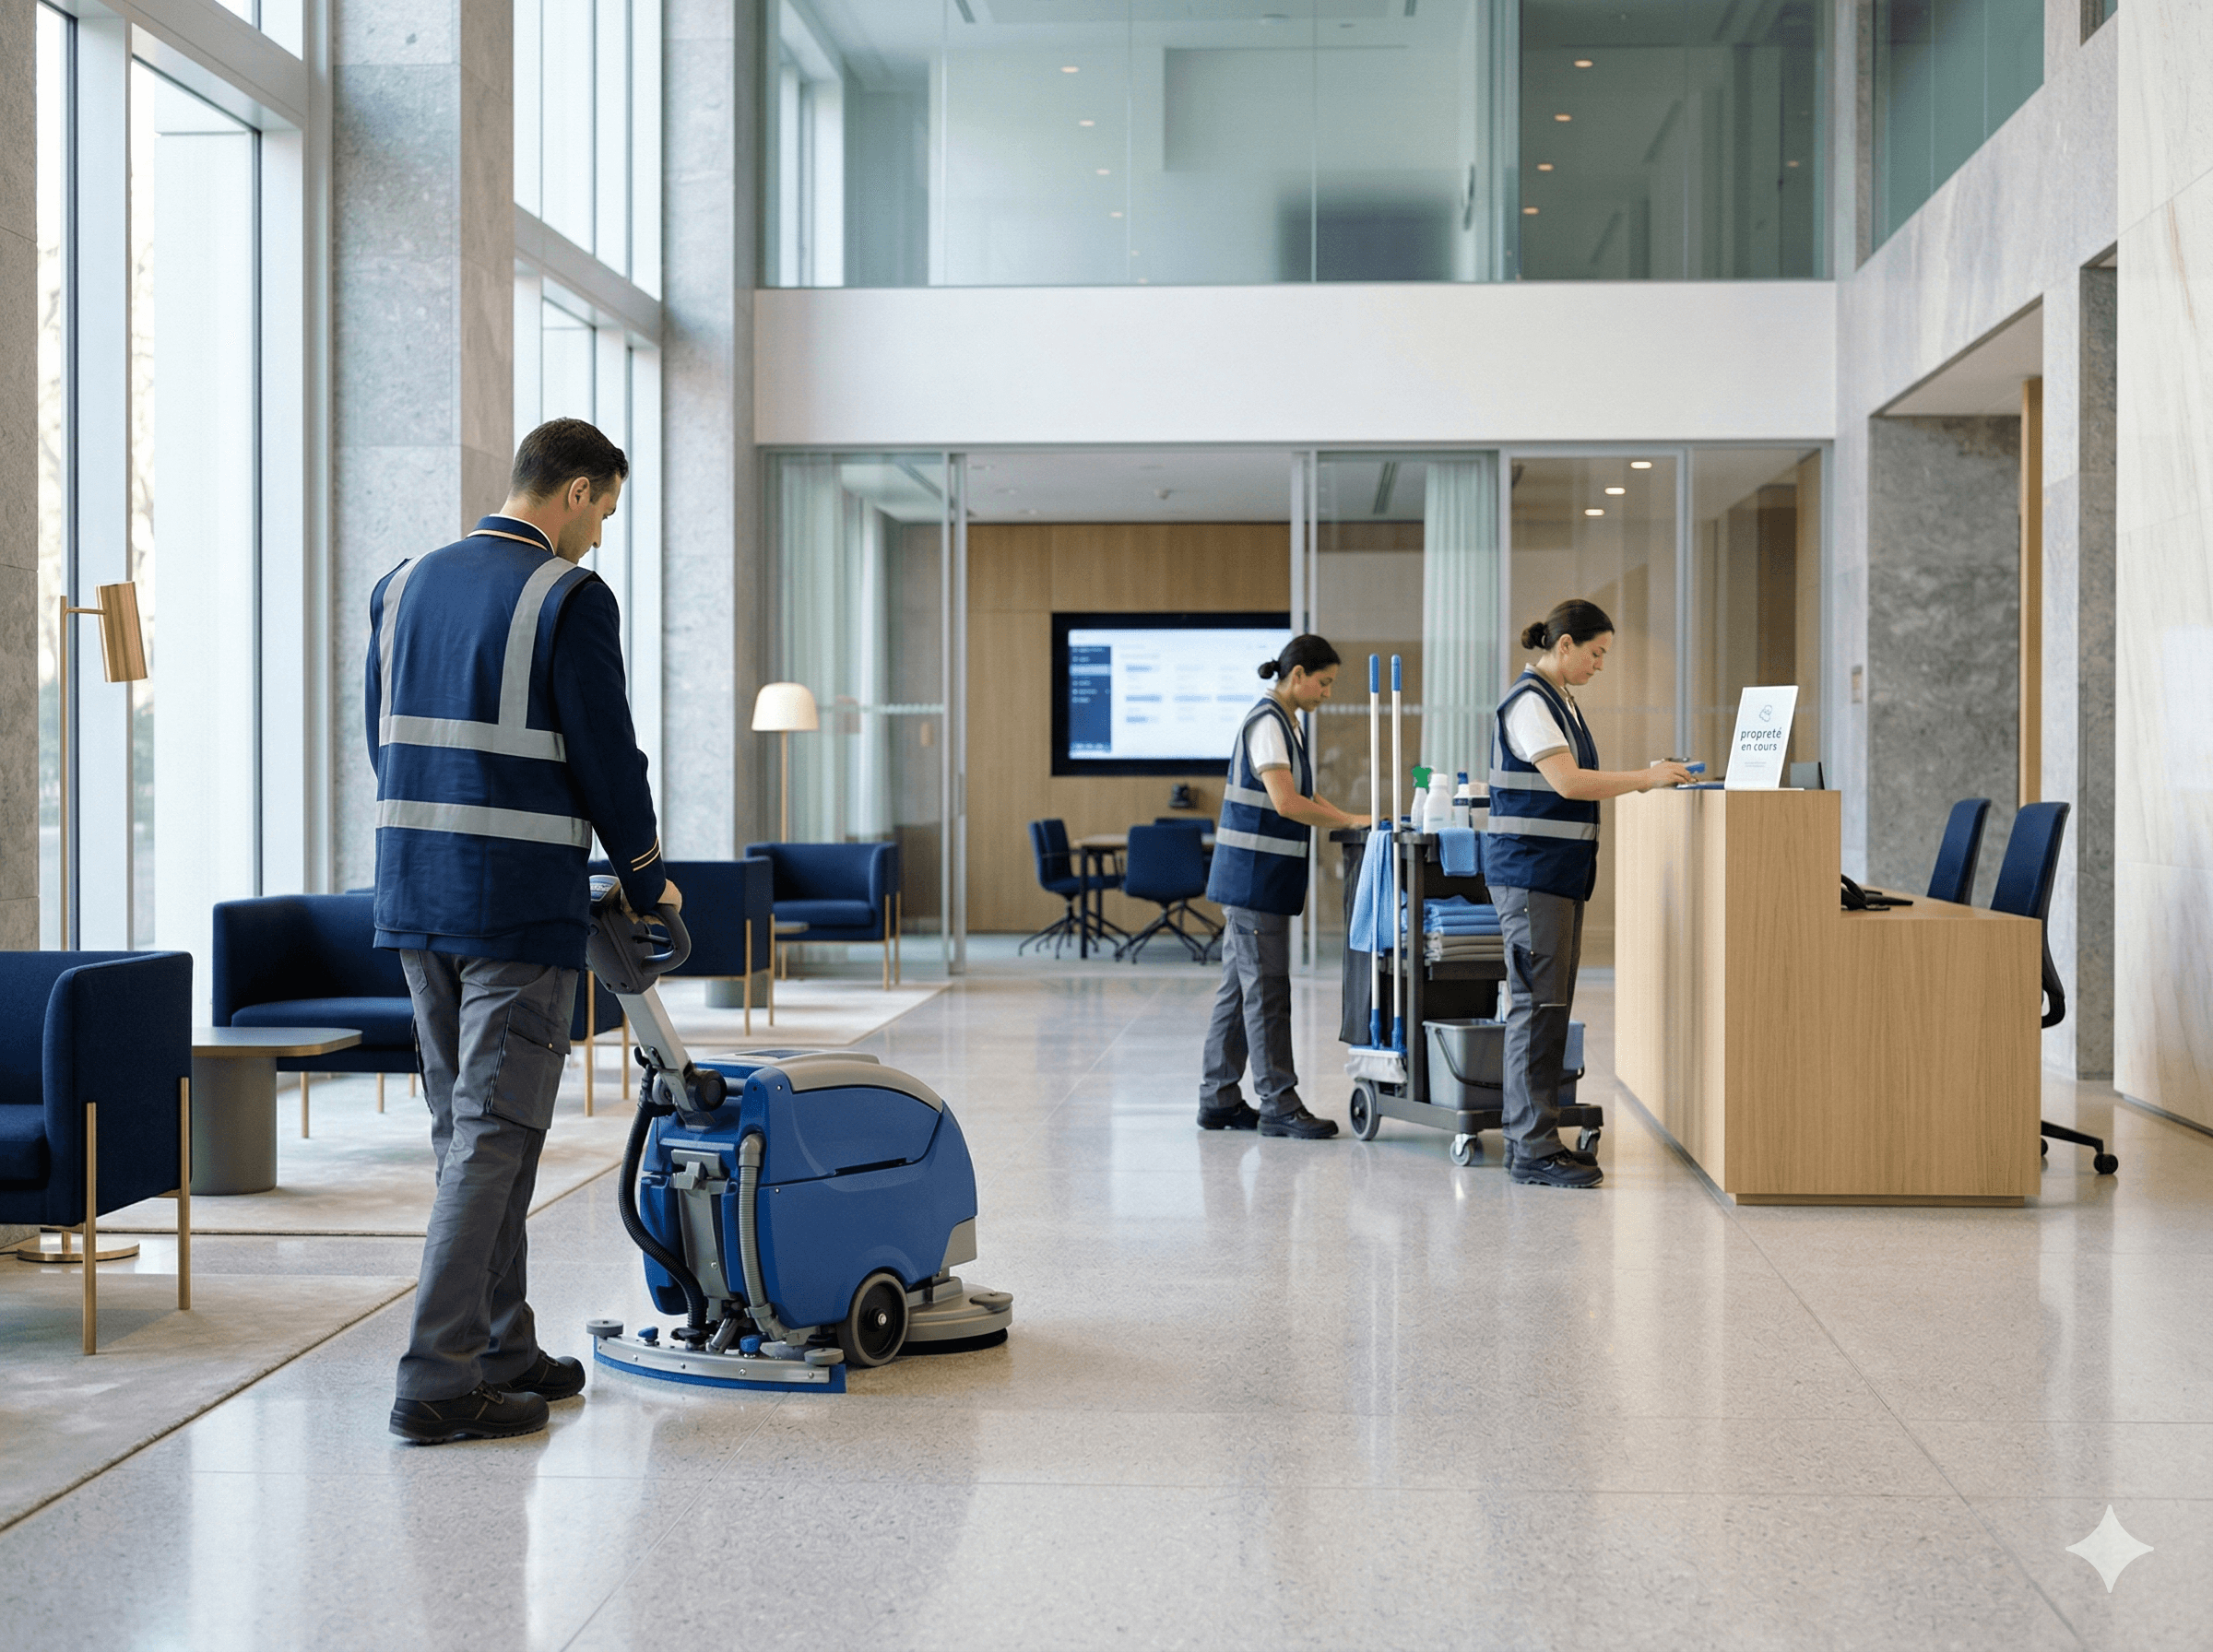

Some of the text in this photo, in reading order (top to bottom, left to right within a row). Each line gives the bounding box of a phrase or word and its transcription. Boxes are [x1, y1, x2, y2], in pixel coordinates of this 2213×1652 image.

[1740, 726, 1781, 741] propreté
[1741, 743, 1777, 751] en cours
